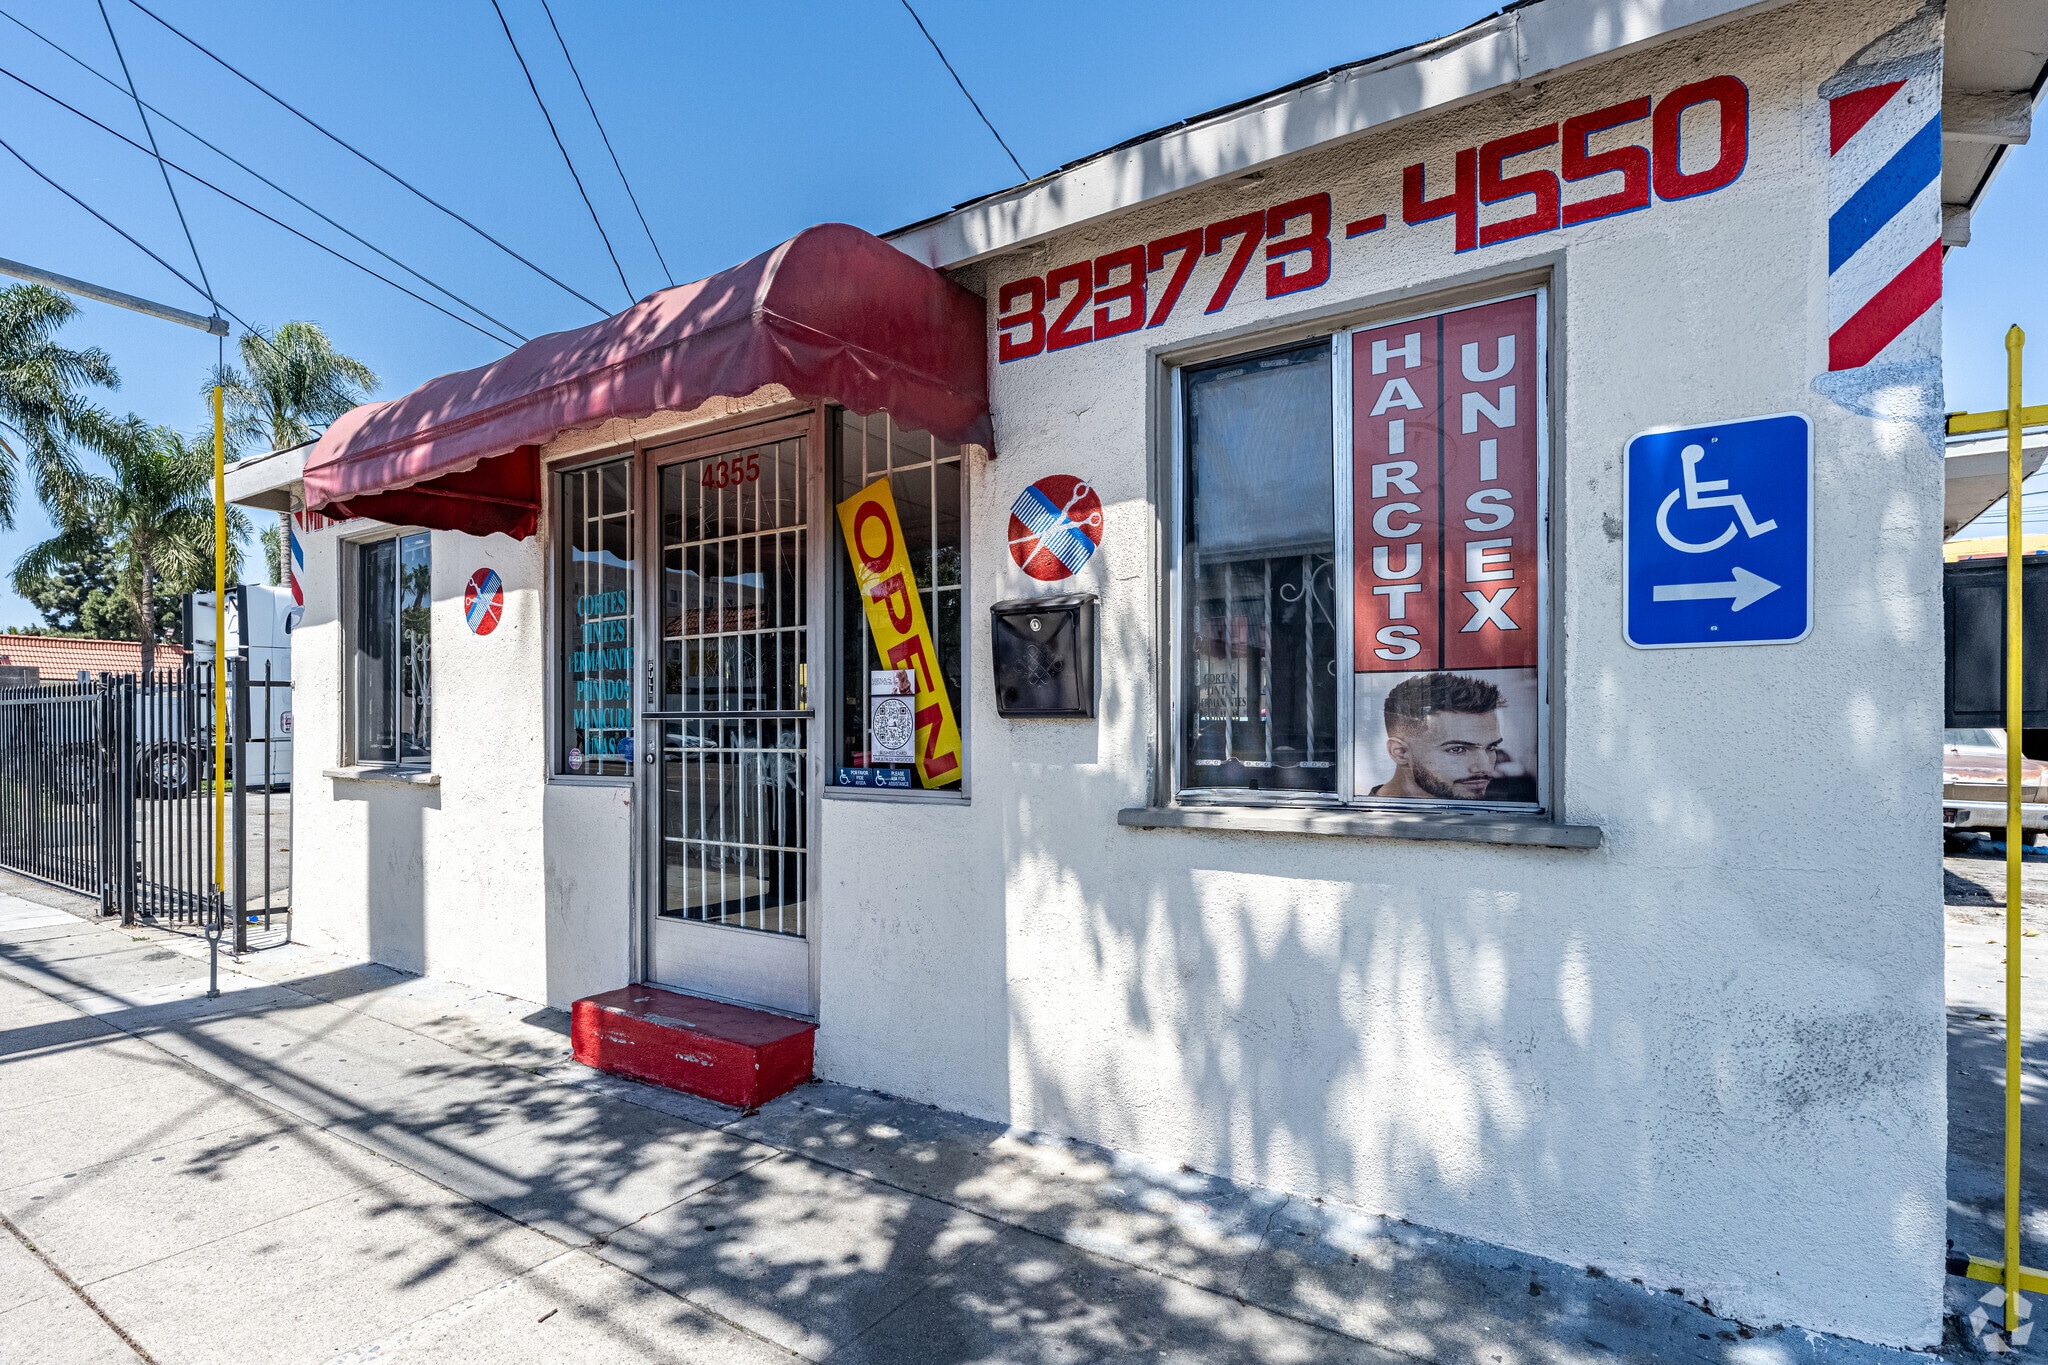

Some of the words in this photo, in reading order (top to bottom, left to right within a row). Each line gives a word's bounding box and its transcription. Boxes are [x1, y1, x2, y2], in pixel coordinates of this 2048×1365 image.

[702, 454, 760, 490] 4355
[1459, 334, 1521, 633] UNISEX
[1369, 331, 1424, 661] HAIRCUTS
[577, 590, 626, 617] CORTES
[580, 620, 625, 645] TINTES
[854, 500, 958, 780] OPEN
[577, 678, 631, 702] PEINADOS
